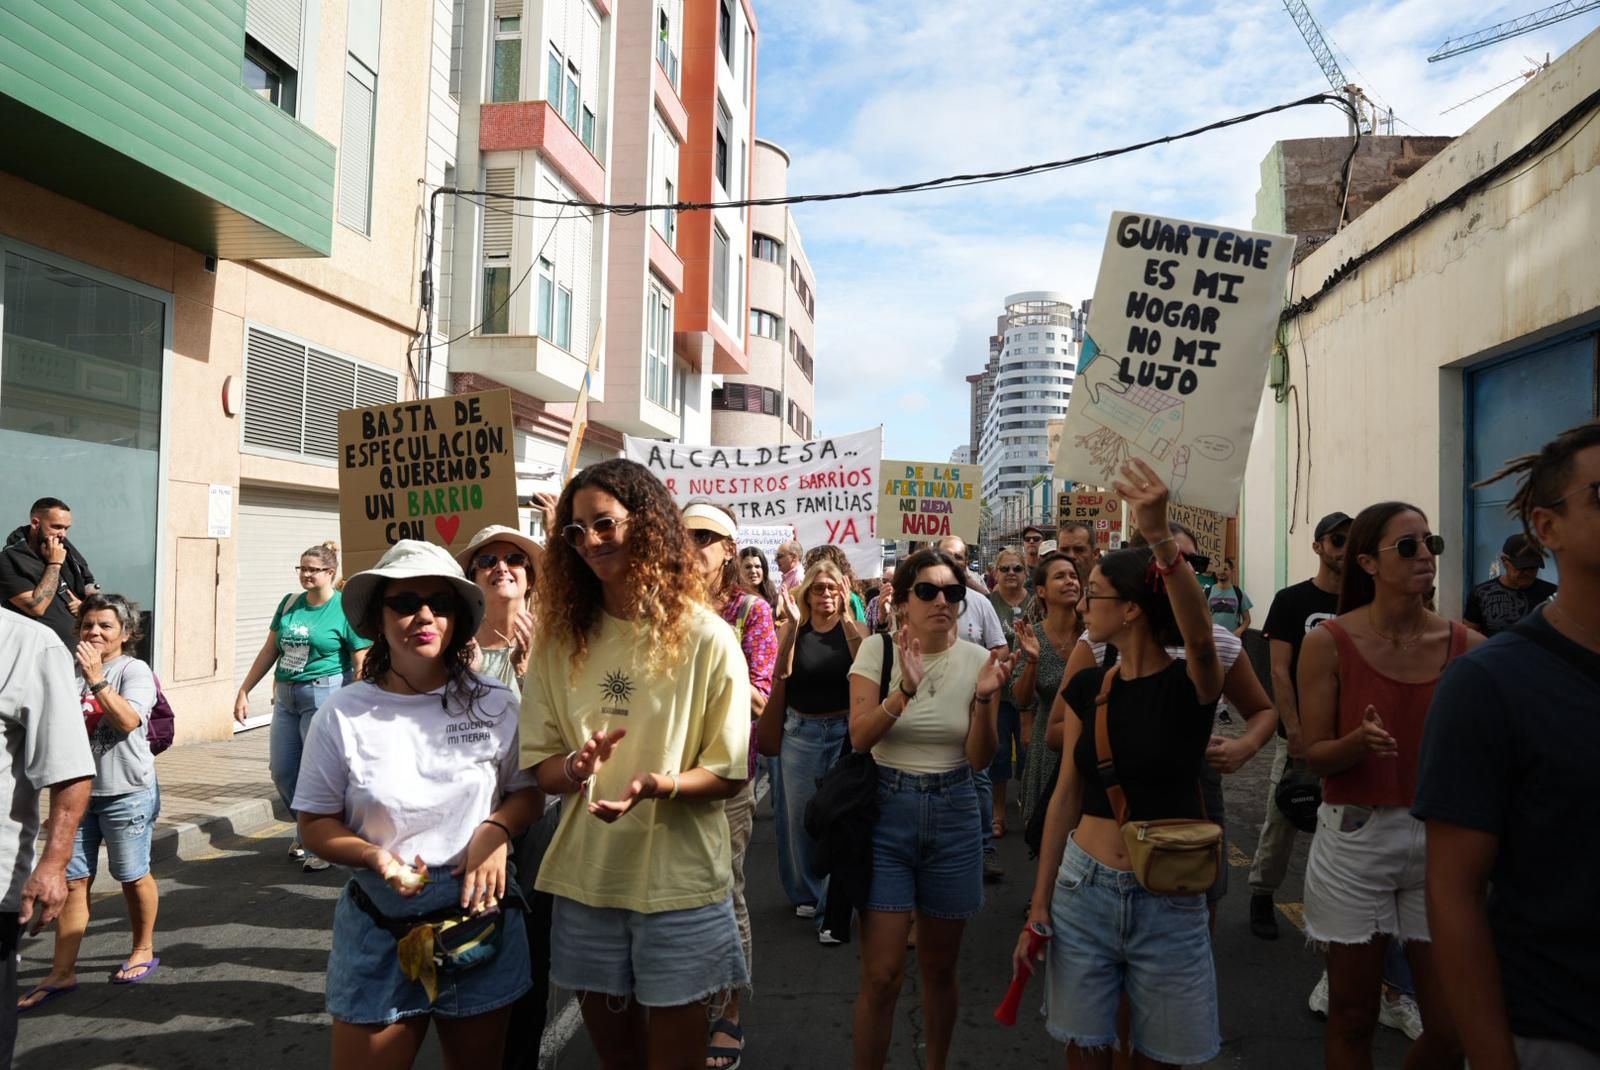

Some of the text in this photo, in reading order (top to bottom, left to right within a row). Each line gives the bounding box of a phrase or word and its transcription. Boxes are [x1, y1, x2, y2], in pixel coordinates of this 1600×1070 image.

[1117, 215, 1272, 270] GUARTEME
[1144, 259, 1245, 304] ES MI
[1126, 291, 1221, 335] HOGAR
[1127, 326, 1221, 368] NO MI
[1119, 357, 1198, 395] LUJO
[362, 398, 483, 440] BASTA DE
[380, 456, 491, 489] QUEREMOS
[906, 466, 960, 480] DE LAS
[689, 476, 789, 495] NUESTROS
[885, 479, 973, 499] AFORTUNADAS
[365, 484, 483, 520] UN BARRIO
[729, 500, 785, 518] TRAS
[899, 499, 953, 513] NO QUEDA
[1060, 496, 1072, 505] EL
[1076, 507, 1087, 516] ES
[1089, 508, 1099, 516] UN
[385, 520, 424, 545] CON
[902, 513, 951, 536] NADA
[1096, 520, 1107, 529] ES
[1168, 505, 1220, 537] NARTEME
[446, 724, 457, 733] MI
[448, 732, 490, 745] MI TIERRA
